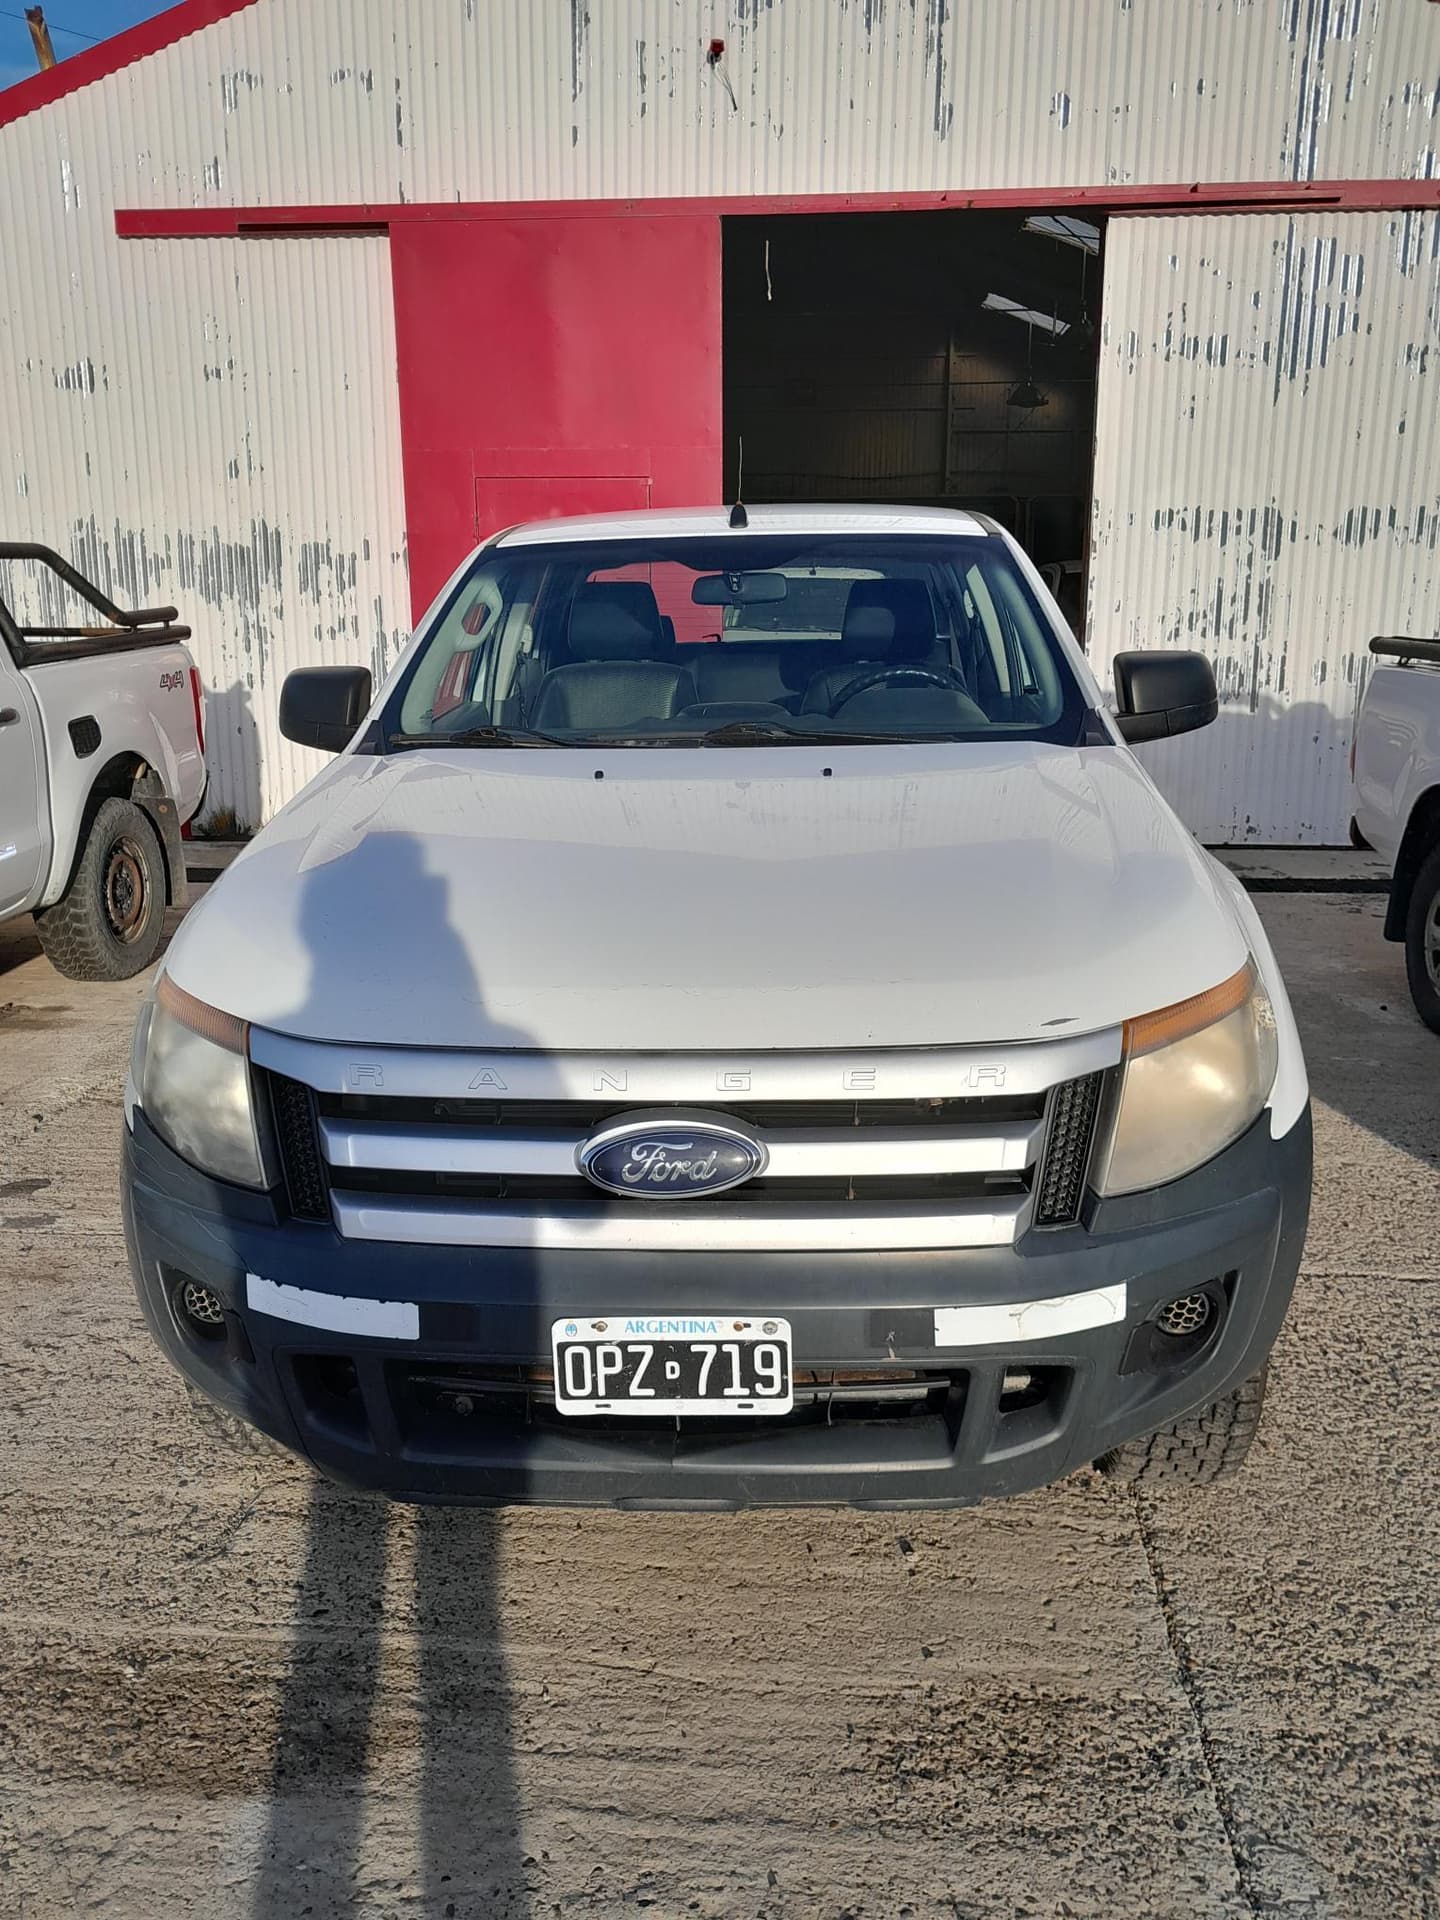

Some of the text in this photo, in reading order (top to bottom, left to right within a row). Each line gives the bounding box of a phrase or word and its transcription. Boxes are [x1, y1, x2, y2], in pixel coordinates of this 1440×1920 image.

[350, 1063, 1007, 1092] RANGER
[622, 1142, 717, 1184] Ford
[625, 1320, 717, 1334] ARGENTINA
[564, 1345, 655, 1397] OPZ
[690, 1344, 782, 1396] 719
